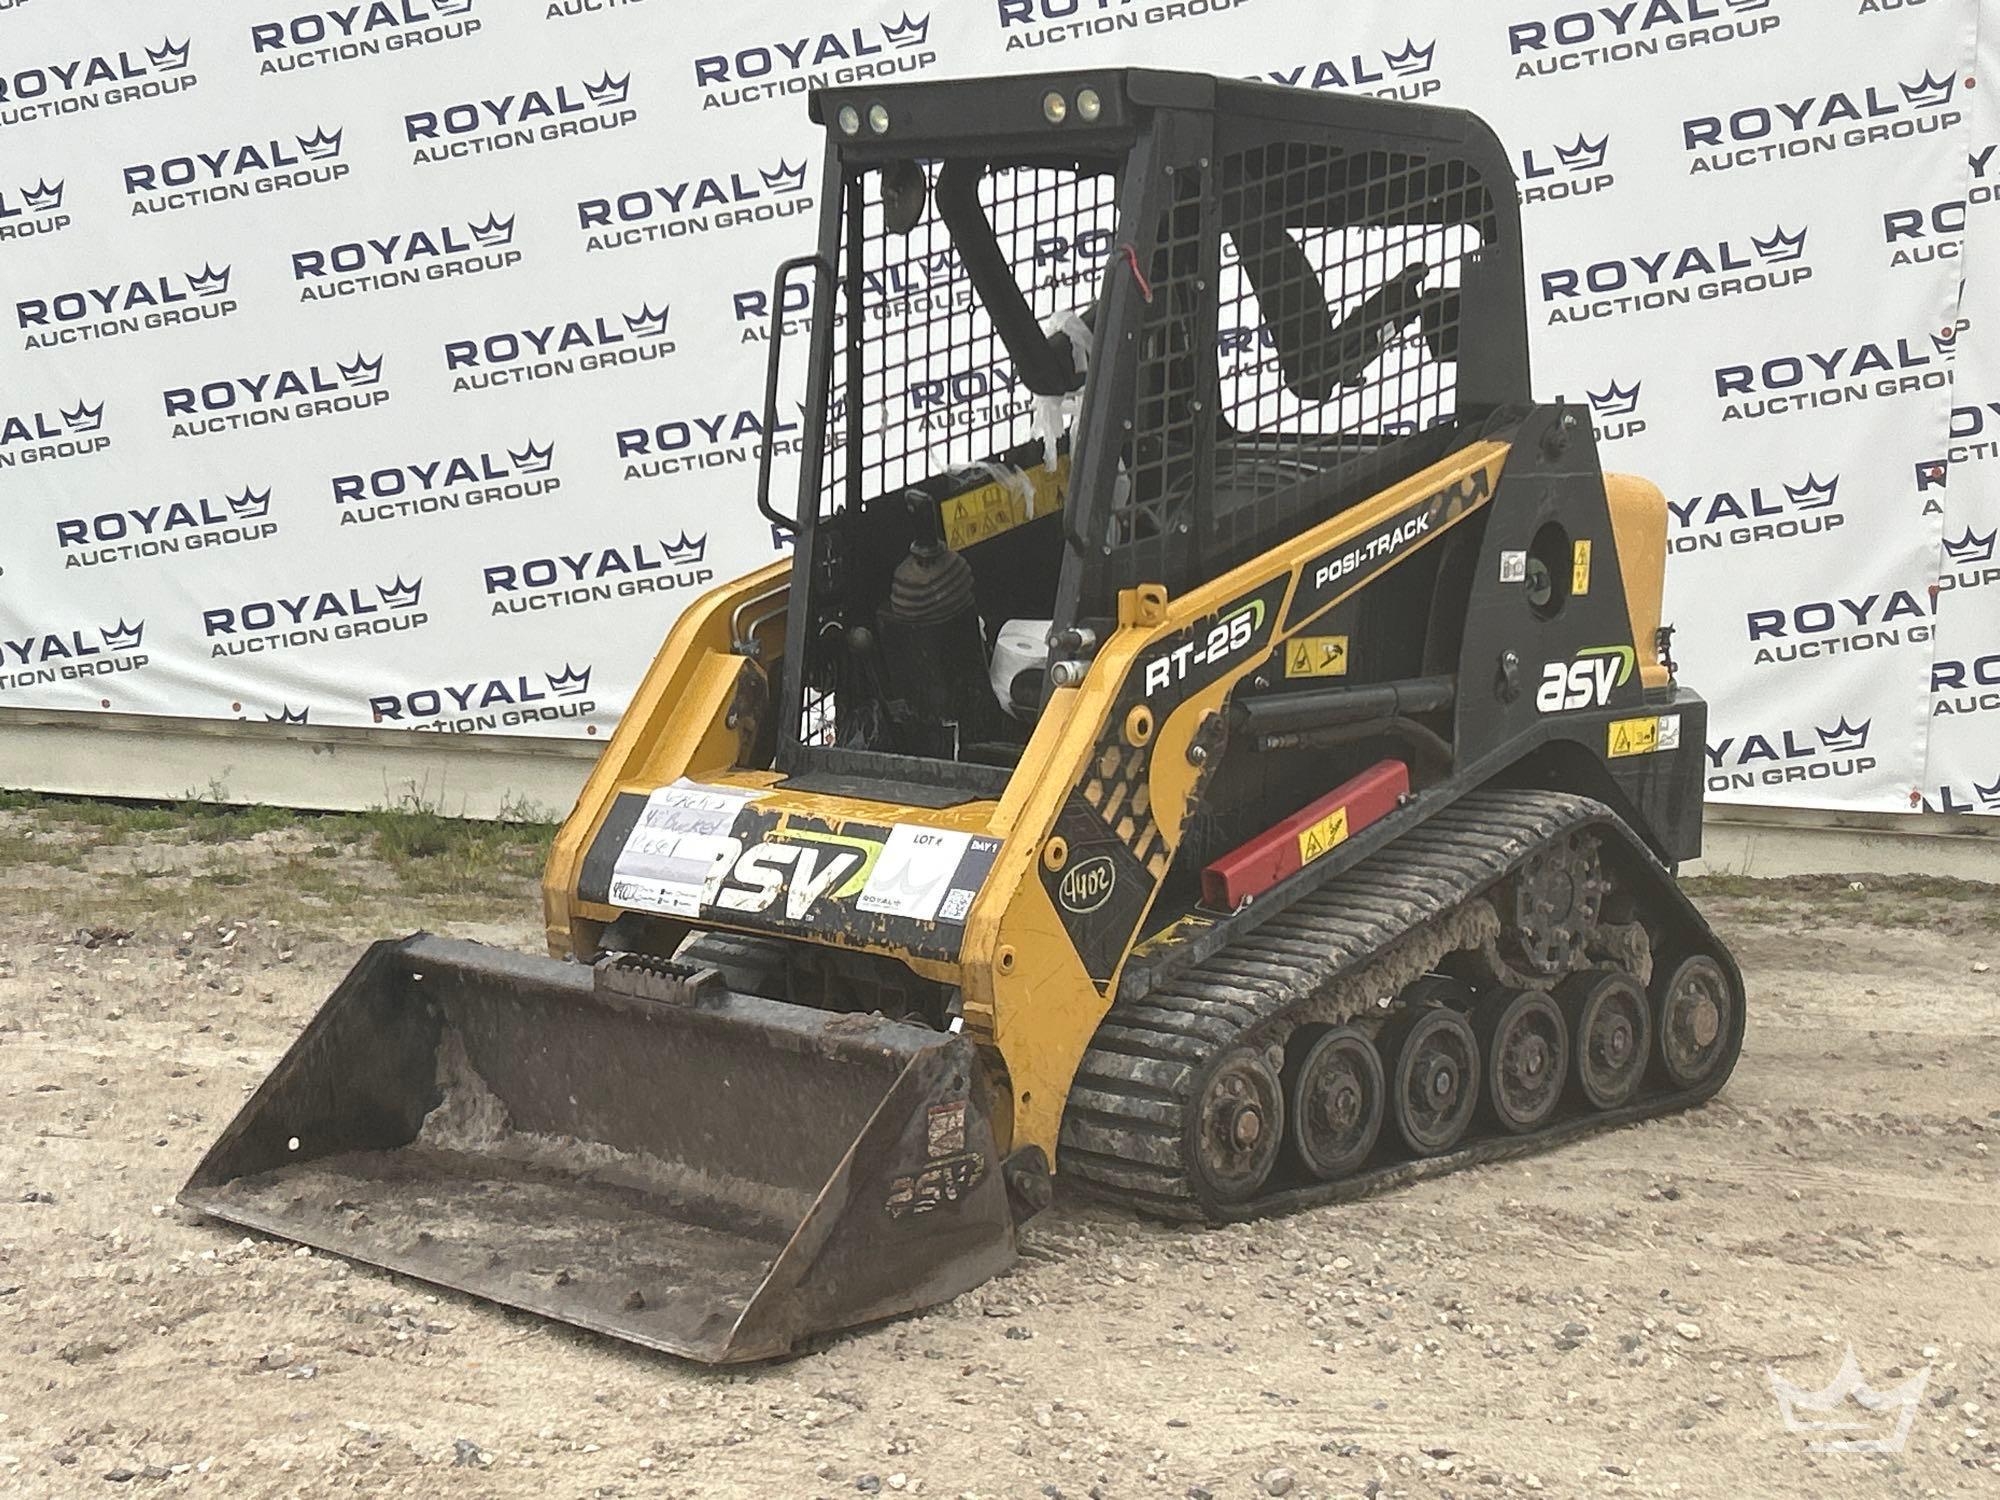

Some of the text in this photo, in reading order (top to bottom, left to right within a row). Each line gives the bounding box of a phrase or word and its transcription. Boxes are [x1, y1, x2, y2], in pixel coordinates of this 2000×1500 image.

[252, 0, 429, 53] ROYAL
[261, 19, 481, 75] AUCTION GROUP
[1006, 12, 1138, 51] AUCTION
[1509, 0, 1719, 55] ROYAL
[1516, 16, 1780, 79] AUCTION GROUP
[695, 26, 882, 87] ROYAL
[703, 51, 937, 110] AUCTION GROUP
[0, 75, 197, 125] UCTION GROUP
[405, 86, 584, 142] ROYAL
[1683, 87, 1899, 150] ROYAL
[413, 110, 636, 165] AUCTION GROUP
[1690, 112, 1961, 175] AUCTION GROUP
[123, 141, 298, 194] ROYAL
[132, 164, 349, 216] AUCTION GROUP
[578, 174, 760, 229] ROYAL
[587, 198, 813, 252] AUCTION GROUP
[0, 214, 70, 241] ROUP
[292, 227, 470, 280] ROYAL
[301, 251, 521, 302] AUCTION GROUP
[1541, 242, 1751, 301] ROYAL
[16, 277, 186, 328] ROYAL
[1548, 267, 1812, 325] AUCTION GROUP
[25, 301, 237, 350] AUCTION GROUP
[445, 318, 624, 370] ROYAL
[163, 367, 338, 417] ROYAL
[453, 342, 675, 392] AUCTION GROUP
[1715, 339, 1930, 397] ROYAL
[172, 391, 389, 438] AUCTION GROUP
[1722, 370, 1953, 421] AUCTION GRO
[21, 437, 110, 463] GROUP
[616, 405, 798, 458] ROYAL
[332, 454, 509, 503] ROYAL
[624, 448, 746, 480] AUCTION
[56, 499, 227, 547] ROYAL
[341, 478, 560, 525] AUCTION GROUP
[1667, 488, 1783, 528] YAL
[66, 523, 277, 569] AUCTION GROUP
[1315, 511, 1429, 589] POSI-TRACK
[1730, 514, 1844, 544] GROUP
[484, 545, 661, 594] ROYAL
[492, 570, 713, 616] AUCTION GROUP
[203, 589, 378, 636] ROYAL
[212, 613, 428, 658] AUCTION GROUP
[0, 631, 100, 667] YAL
[60, 655, 148, 679] GROUP
[1145, 611, 1252, 697] RT-25
[1754, 630, 1899, 664] AUCTION
[369, 676, 545, 723] ROYAL
[502, 701, 595, 726] GROUP
[1705, 731, 1815, 768] YAL
[1762, 757, 1876, 784] GROUP
[913, 834, 935, 845] LOT
[971, 840, 990, 852] DAY
